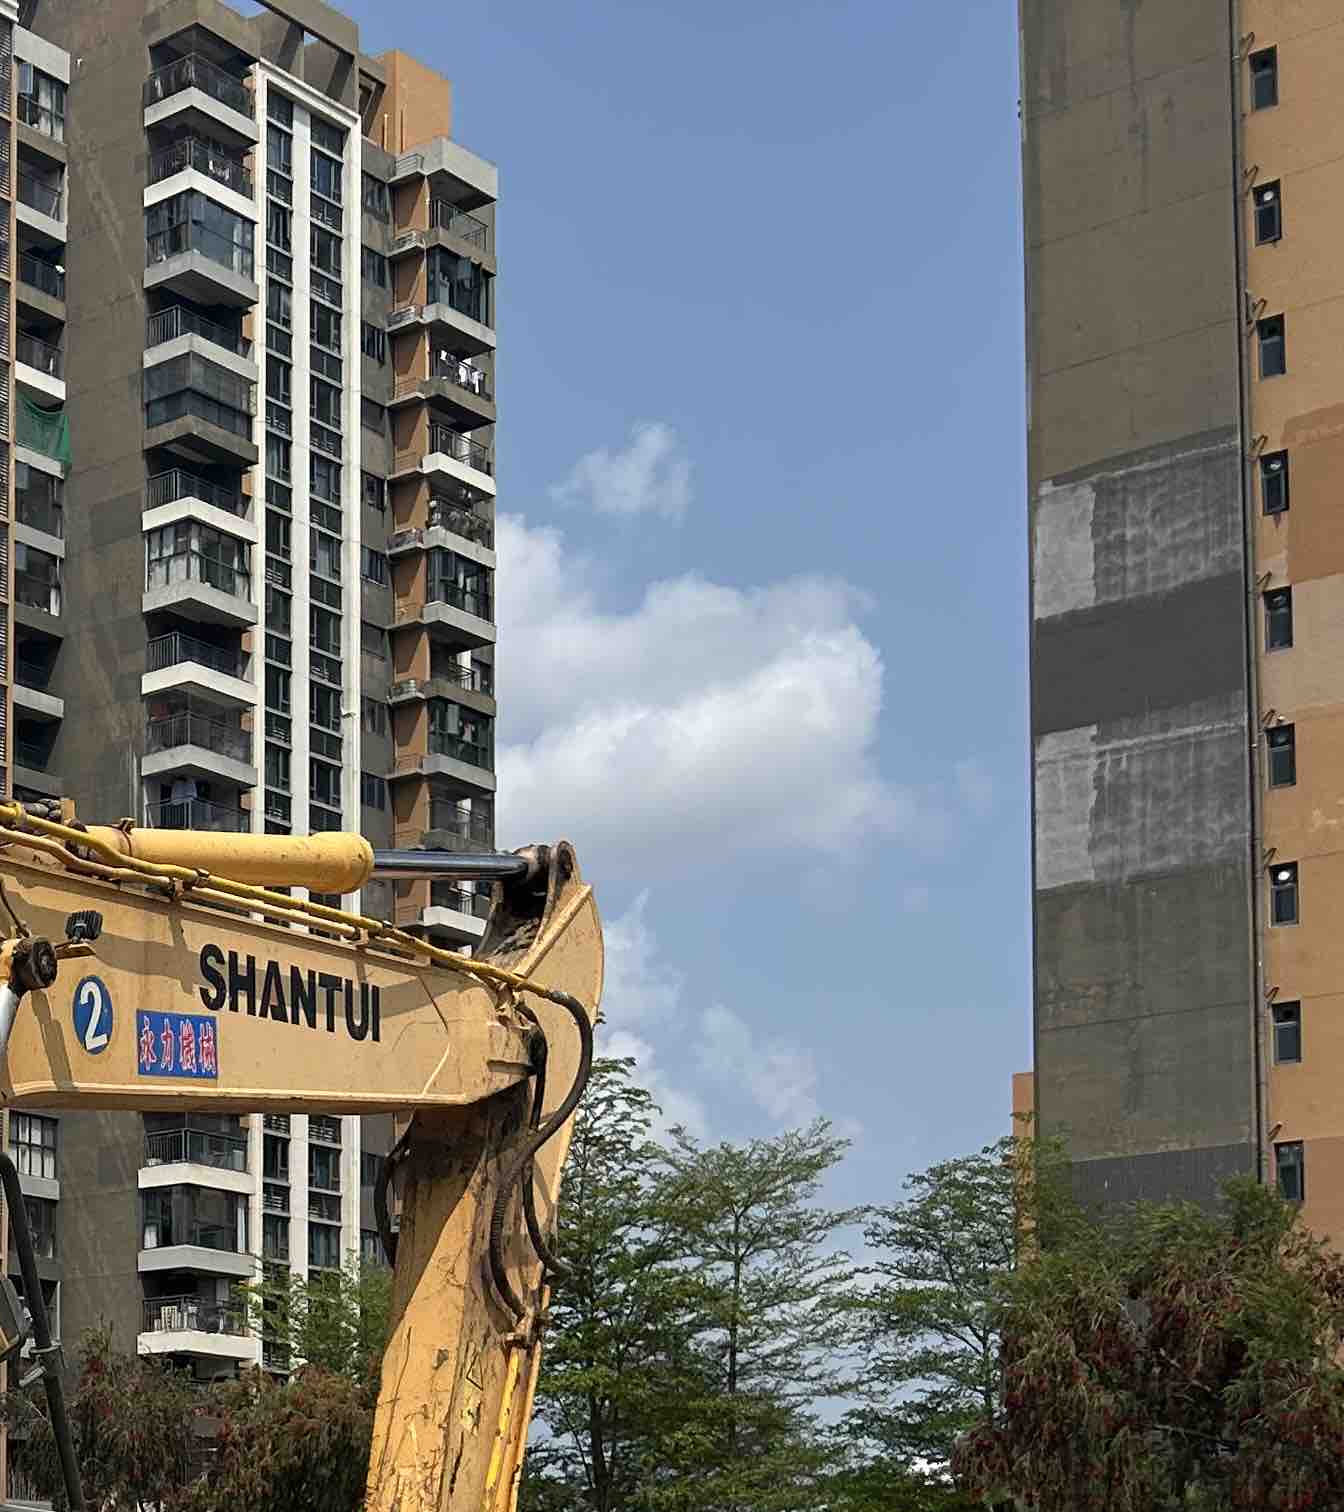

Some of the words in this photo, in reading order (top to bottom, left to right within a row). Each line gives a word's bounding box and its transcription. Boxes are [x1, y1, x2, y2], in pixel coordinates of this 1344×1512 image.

[79, 980, 108, 1051] 2
[199, 943, 381, 1042] SHANTUI
[139, 1015, 217, 1074] 永力機械
